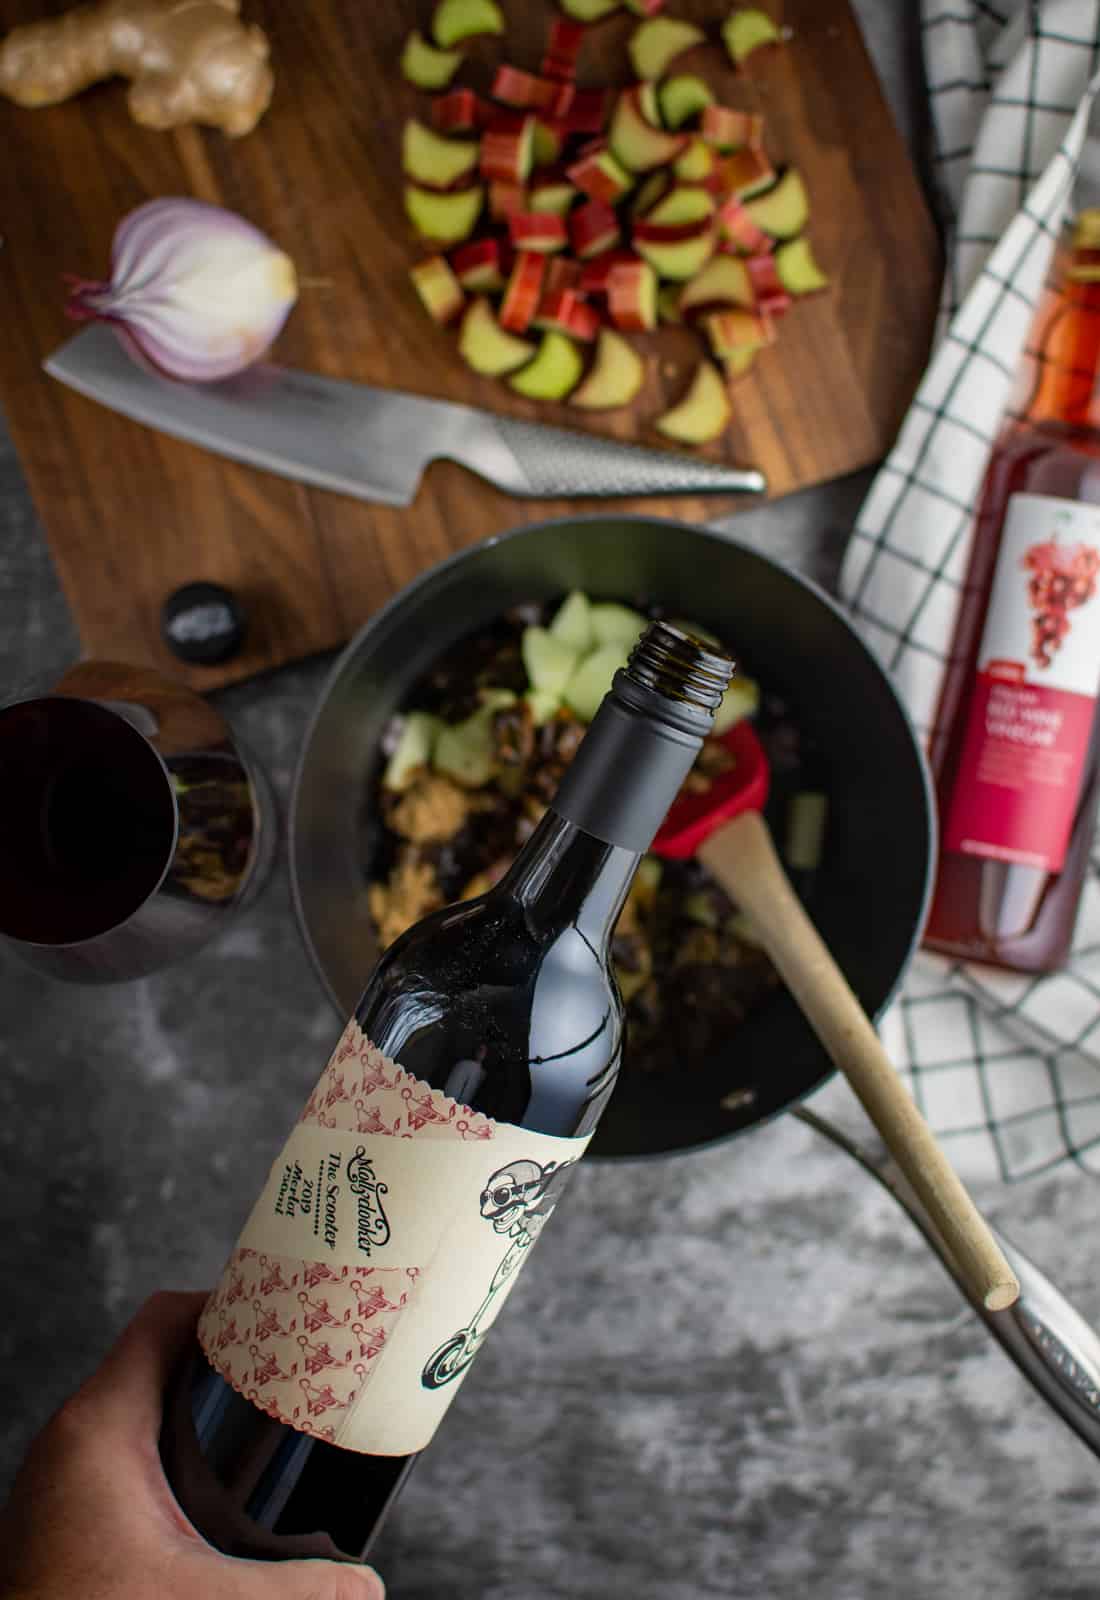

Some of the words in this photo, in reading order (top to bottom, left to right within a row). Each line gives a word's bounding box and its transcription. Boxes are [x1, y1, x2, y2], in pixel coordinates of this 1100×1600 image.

[986, 721, 1055, 747] VINEGAR
[285, 1159, 303, 1218] Merlot
[327, 1152, 341, 1181] The
[300, 1179, 314, 1214] 2019
[324, 1185, 340, 1250] Scooter
[347, 1145, 391, 1257] Mollydooker
